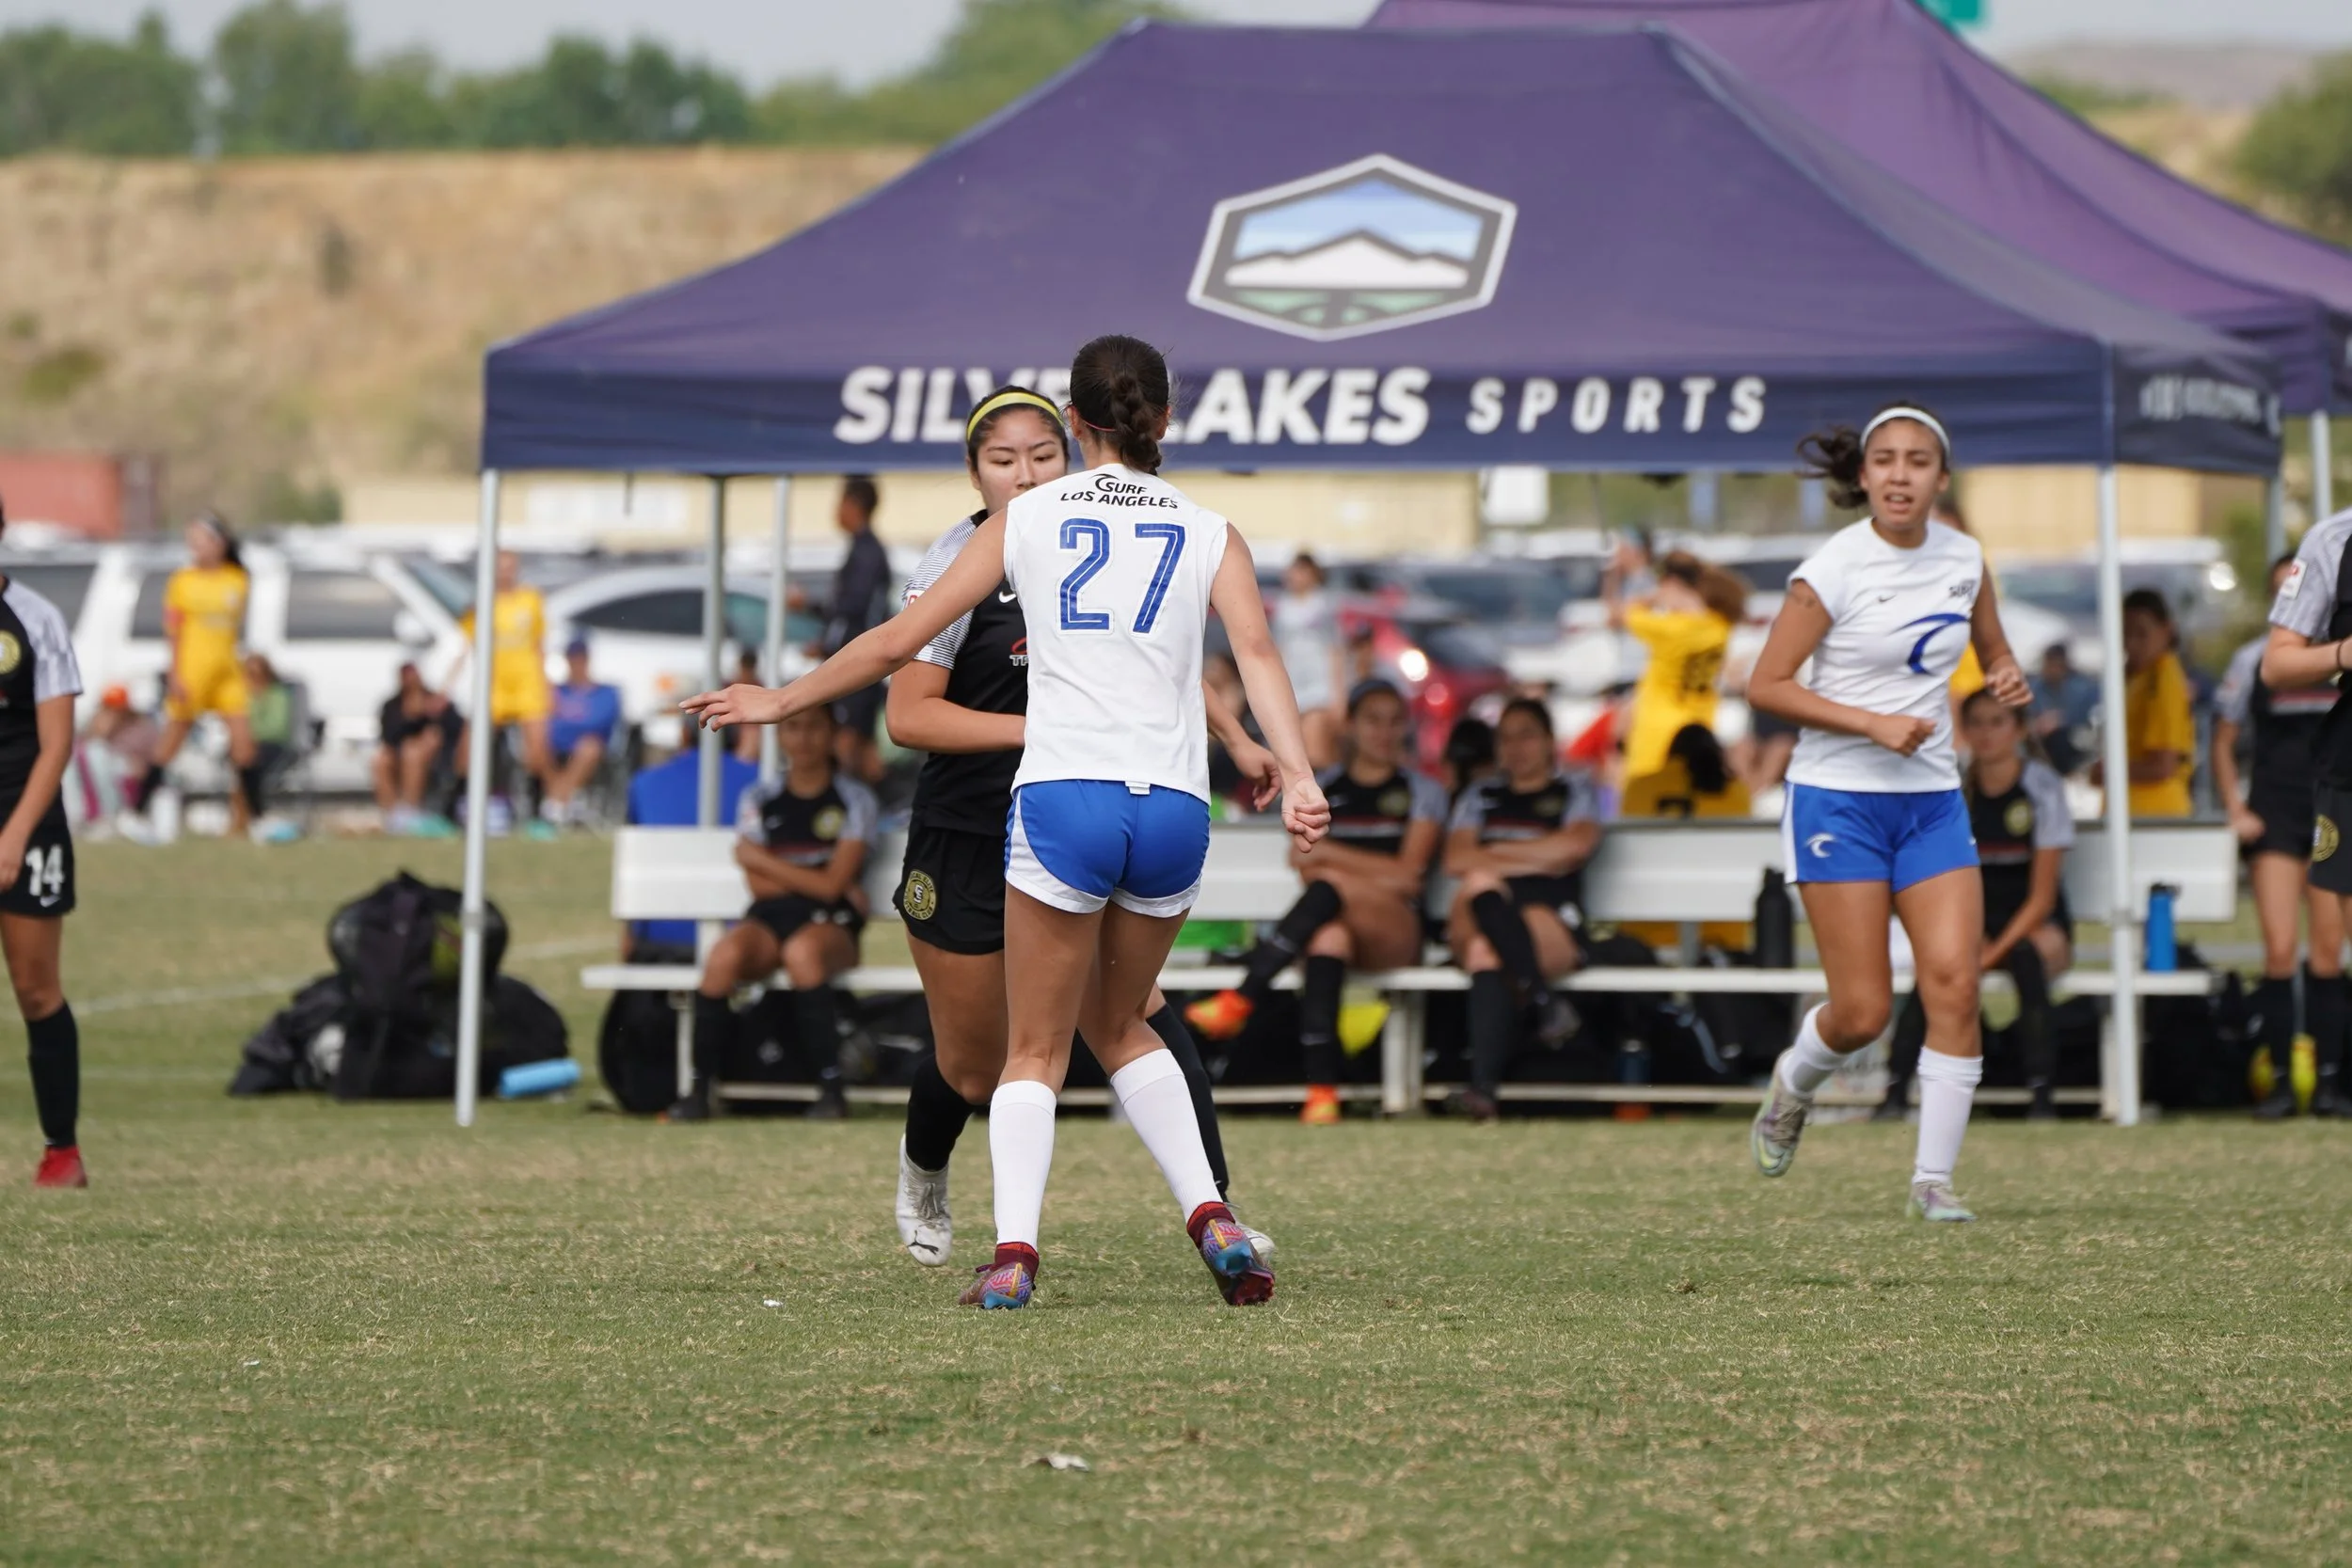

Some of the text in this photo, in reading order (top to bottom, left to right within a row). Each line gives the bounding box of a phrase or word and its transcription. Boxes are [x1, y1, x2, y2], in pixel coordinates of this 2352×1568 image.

[1465, 376, 1765, 434] SPORTS
[1060, 490, 1179, 509] LOS ANGELES
[1104, 482, 1147, 495] SURF
[1059, 517, 1185, 634] 27
[25, 844, 65, 895] 14
